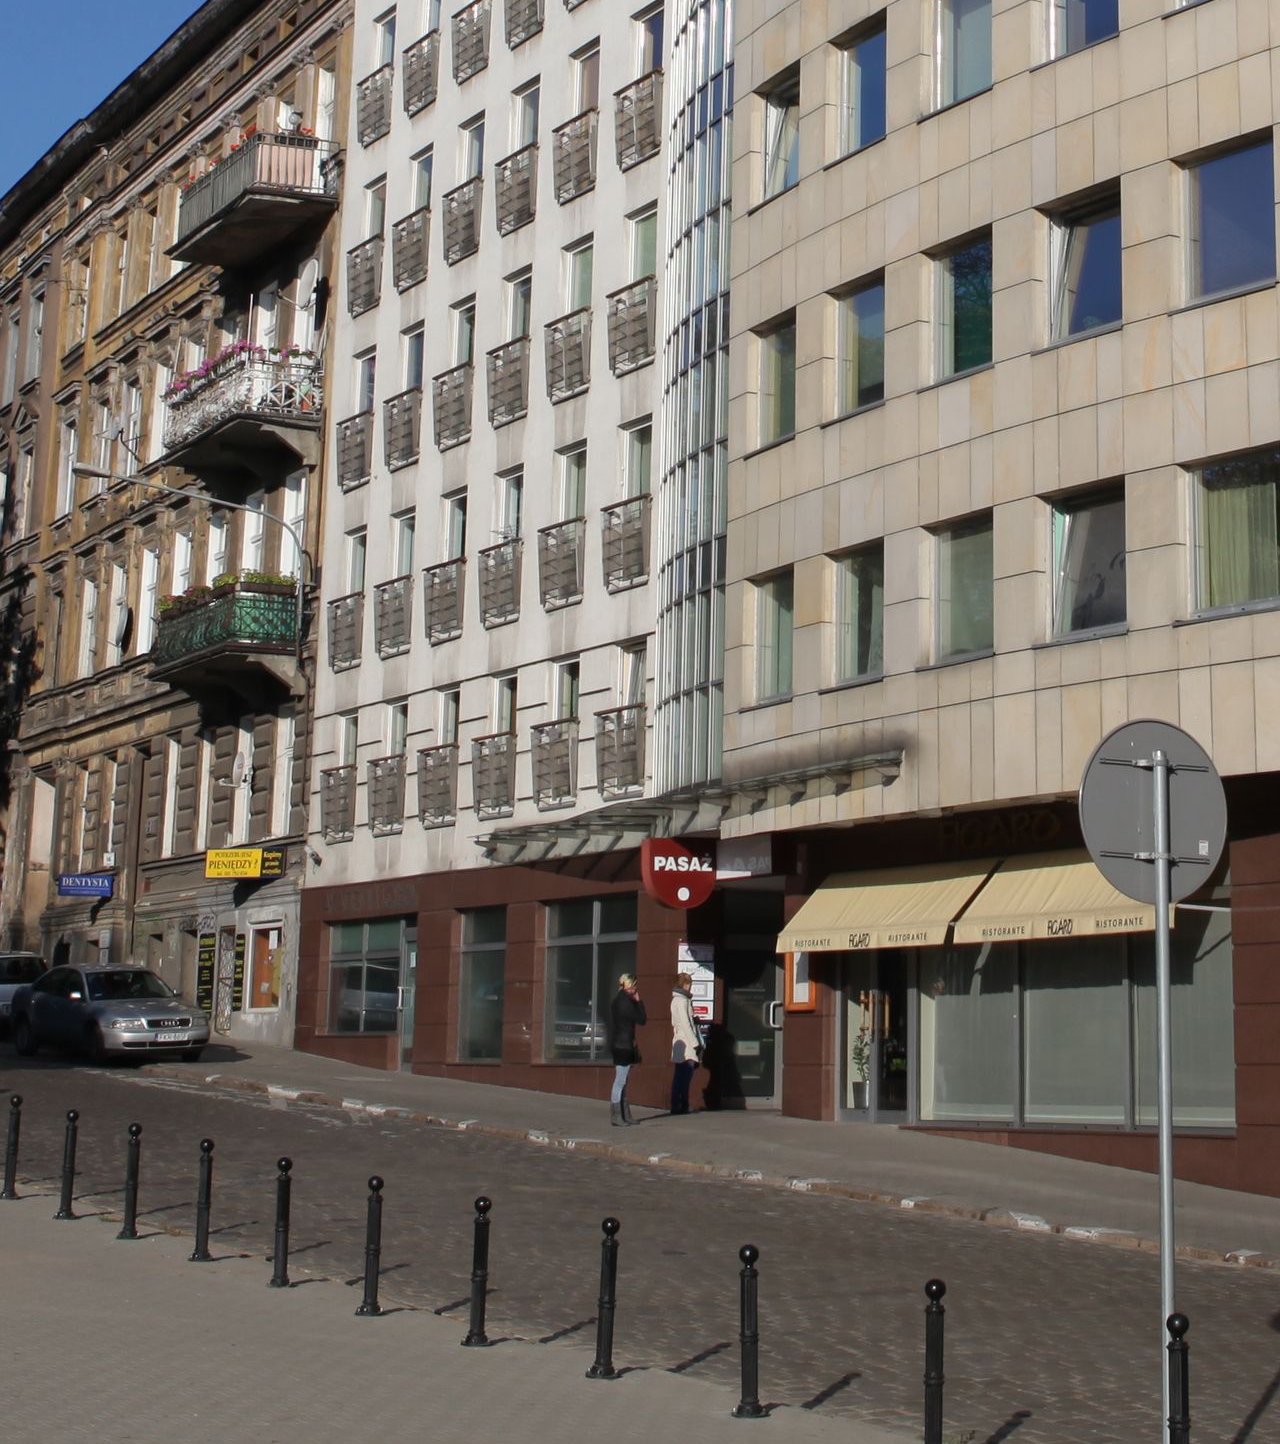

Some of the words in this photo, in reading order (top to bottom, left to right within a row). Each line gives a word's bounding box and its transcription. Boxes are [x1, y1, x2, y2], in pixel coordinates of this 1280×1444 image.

[653, 853, 713, 872] PASAŻ
[62, 877, 109, 887] DENTYSTA
[1095, 917, 1144, 929] RISTORANTE
[982, 926, 1025, 937] RISTORANTE
[795, 938, 831, 948] RISTORANTE
[888, 932, 928, 943] RISTORANTE
